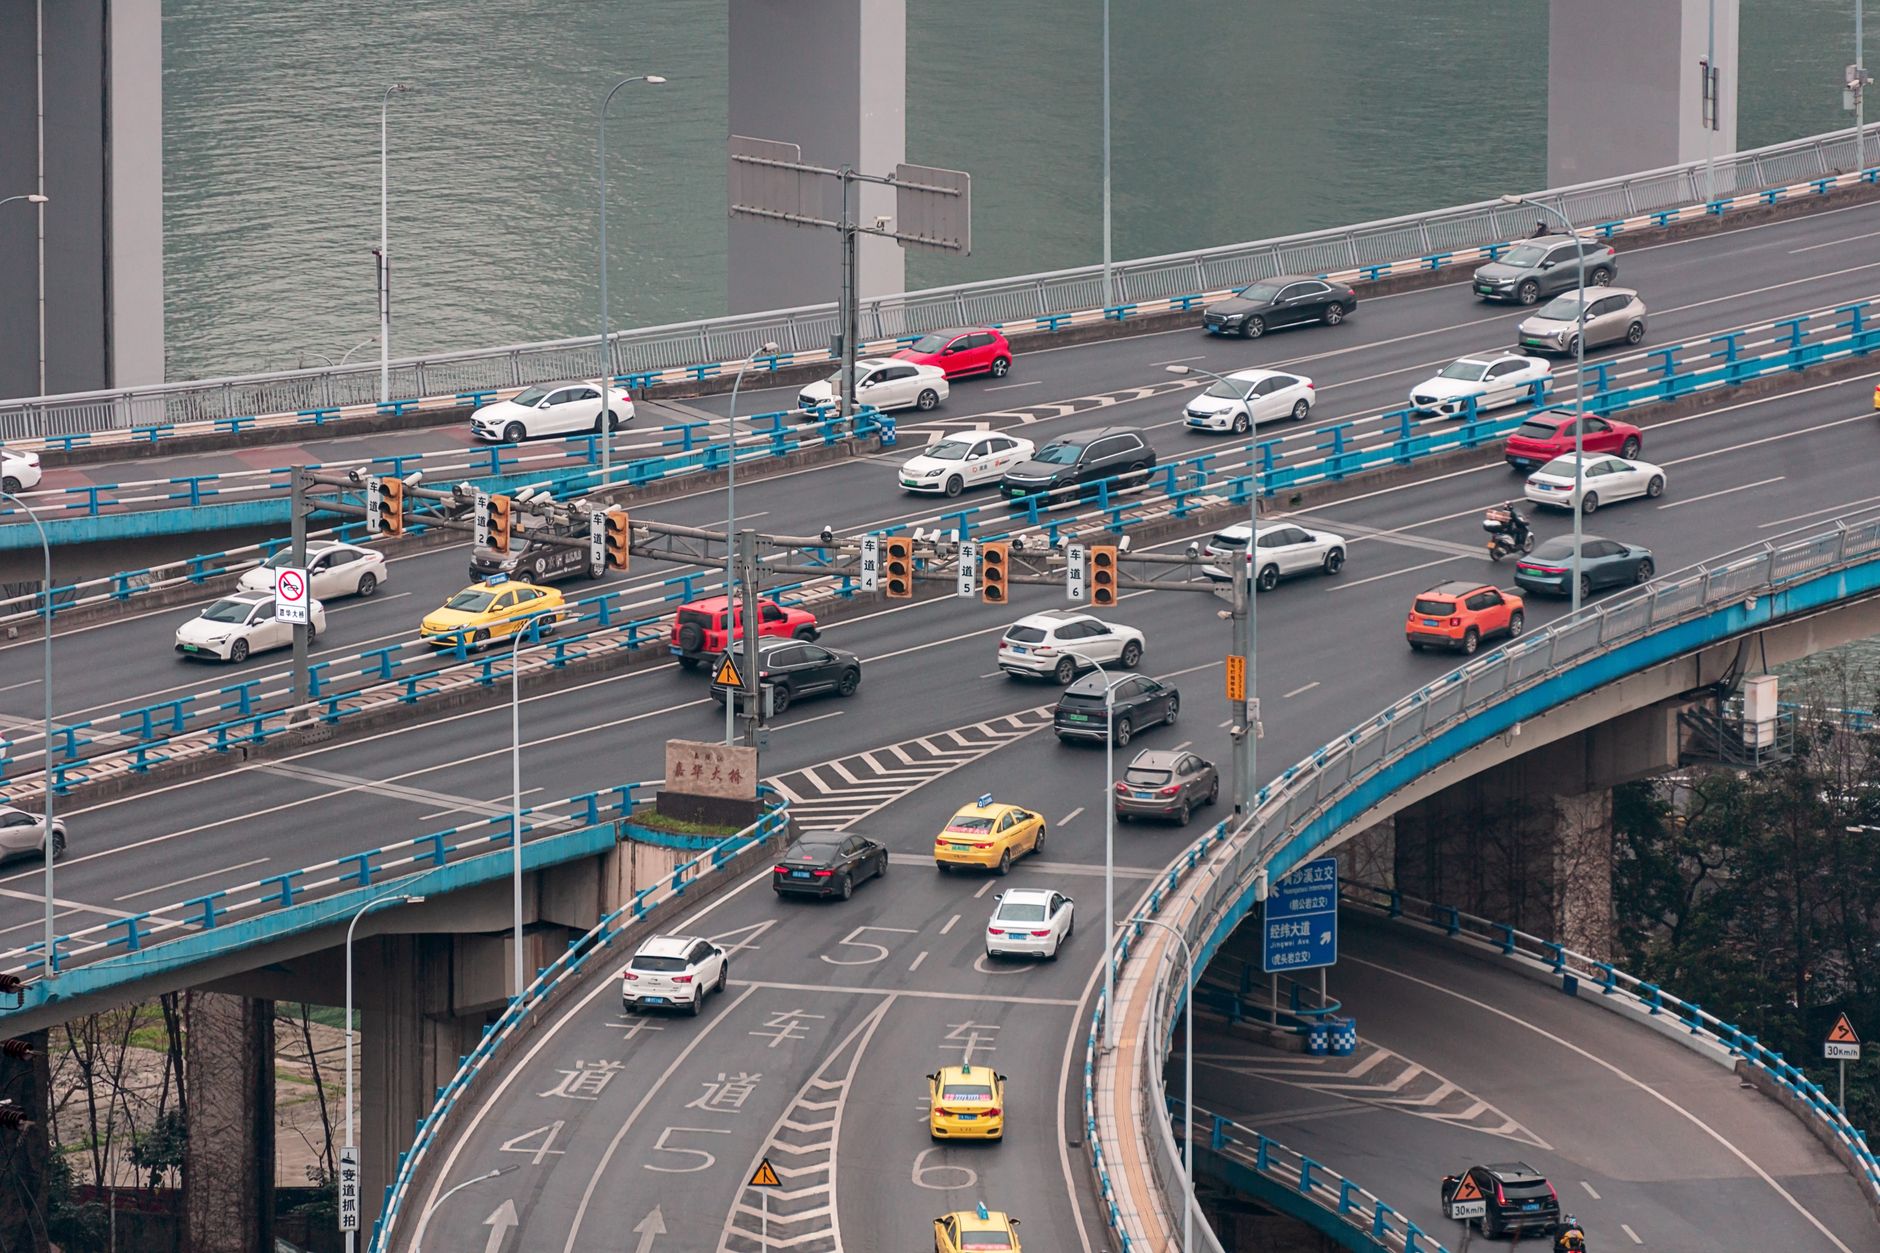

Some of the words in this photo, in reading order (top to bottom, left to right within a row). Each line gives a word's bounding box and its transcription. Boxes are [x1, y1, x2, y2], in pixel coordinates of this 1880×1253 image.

[369, 481, 379, 528] 车道1
[477, 496, 486, 543] 车道2
[593, 513, 602, 560] 车道3
[864, 540, 875, 587] 车道4
[962, 546, 973, 593] 车道5
[1070, 549, 1081, 597] 车道6
[820, 926, 918, 965] 5
[1270, 921, 1310, 939] 经纬大道
[342, 1169, 356, 1227] 变道抓拍
